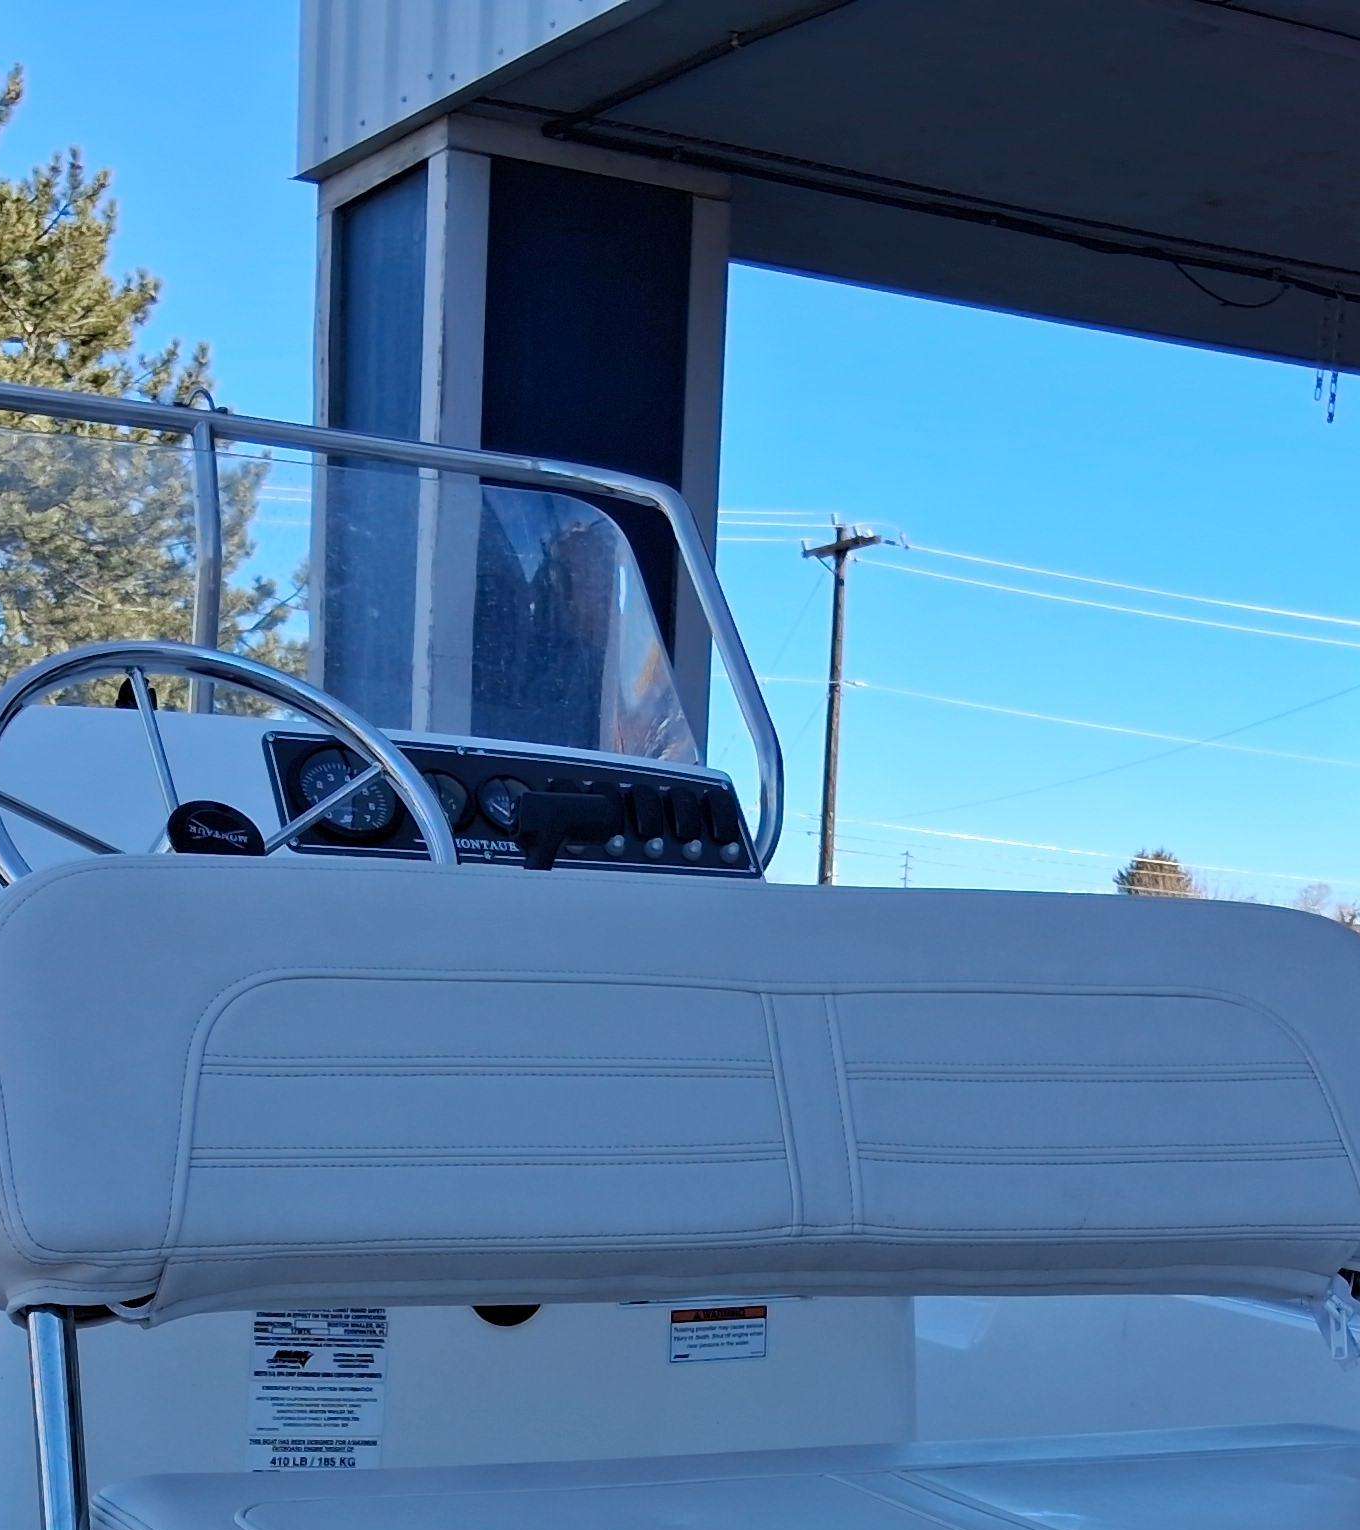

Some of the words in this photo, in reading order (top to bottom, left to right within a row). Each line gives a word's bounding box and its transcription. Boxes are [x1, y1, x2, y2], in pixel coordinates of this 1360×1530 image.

[188, 824, 249, 844] MONTAUK
[269, 1456, 290, 1467] 410
[292, 1456, 308, 1467] LB
[317, 1456, 336, 1467] 185
[339, 1456, 356, 1467] KG
